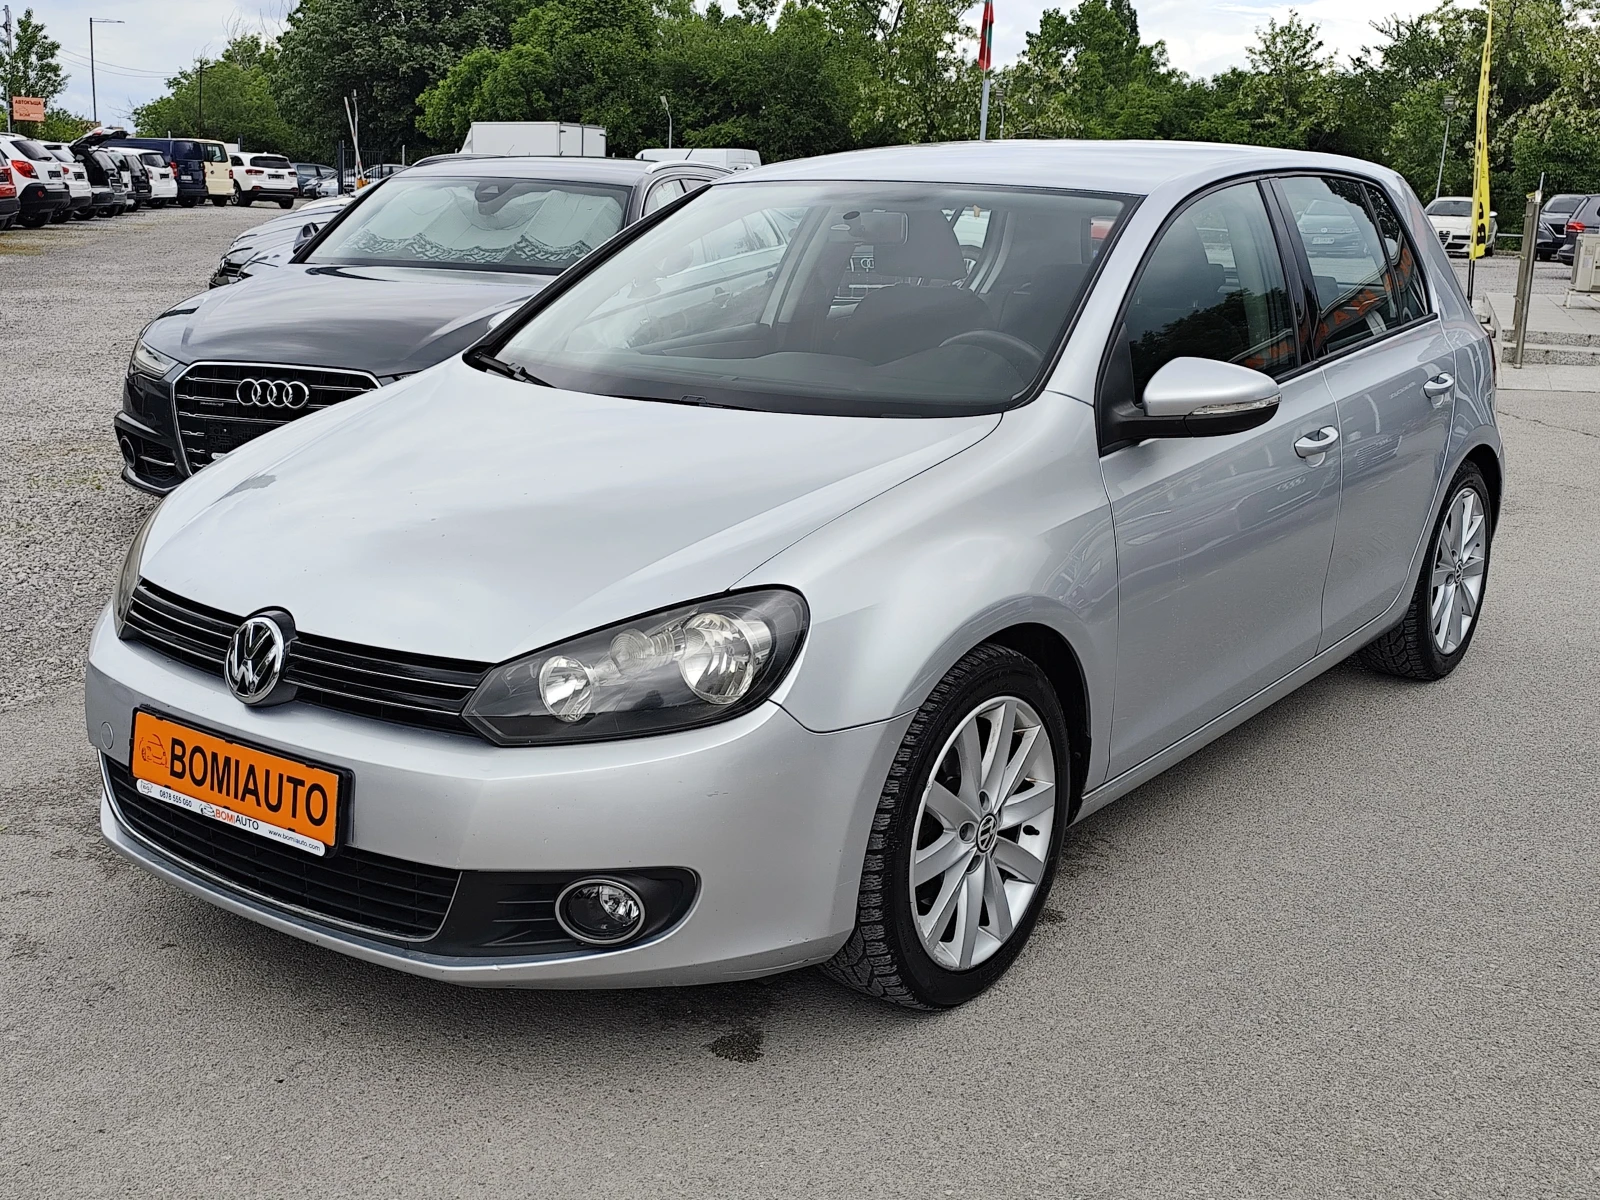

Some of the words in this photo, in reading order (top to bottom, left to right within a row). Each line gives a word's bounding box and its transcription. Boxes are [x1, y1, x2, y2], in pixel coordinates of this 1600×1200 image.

[169, 737, 328, 827] BOMIAUTO
[215, 808, 259, 831] BOMIAUTO
[268, 829, 321, 852] www.bomiauto.com
